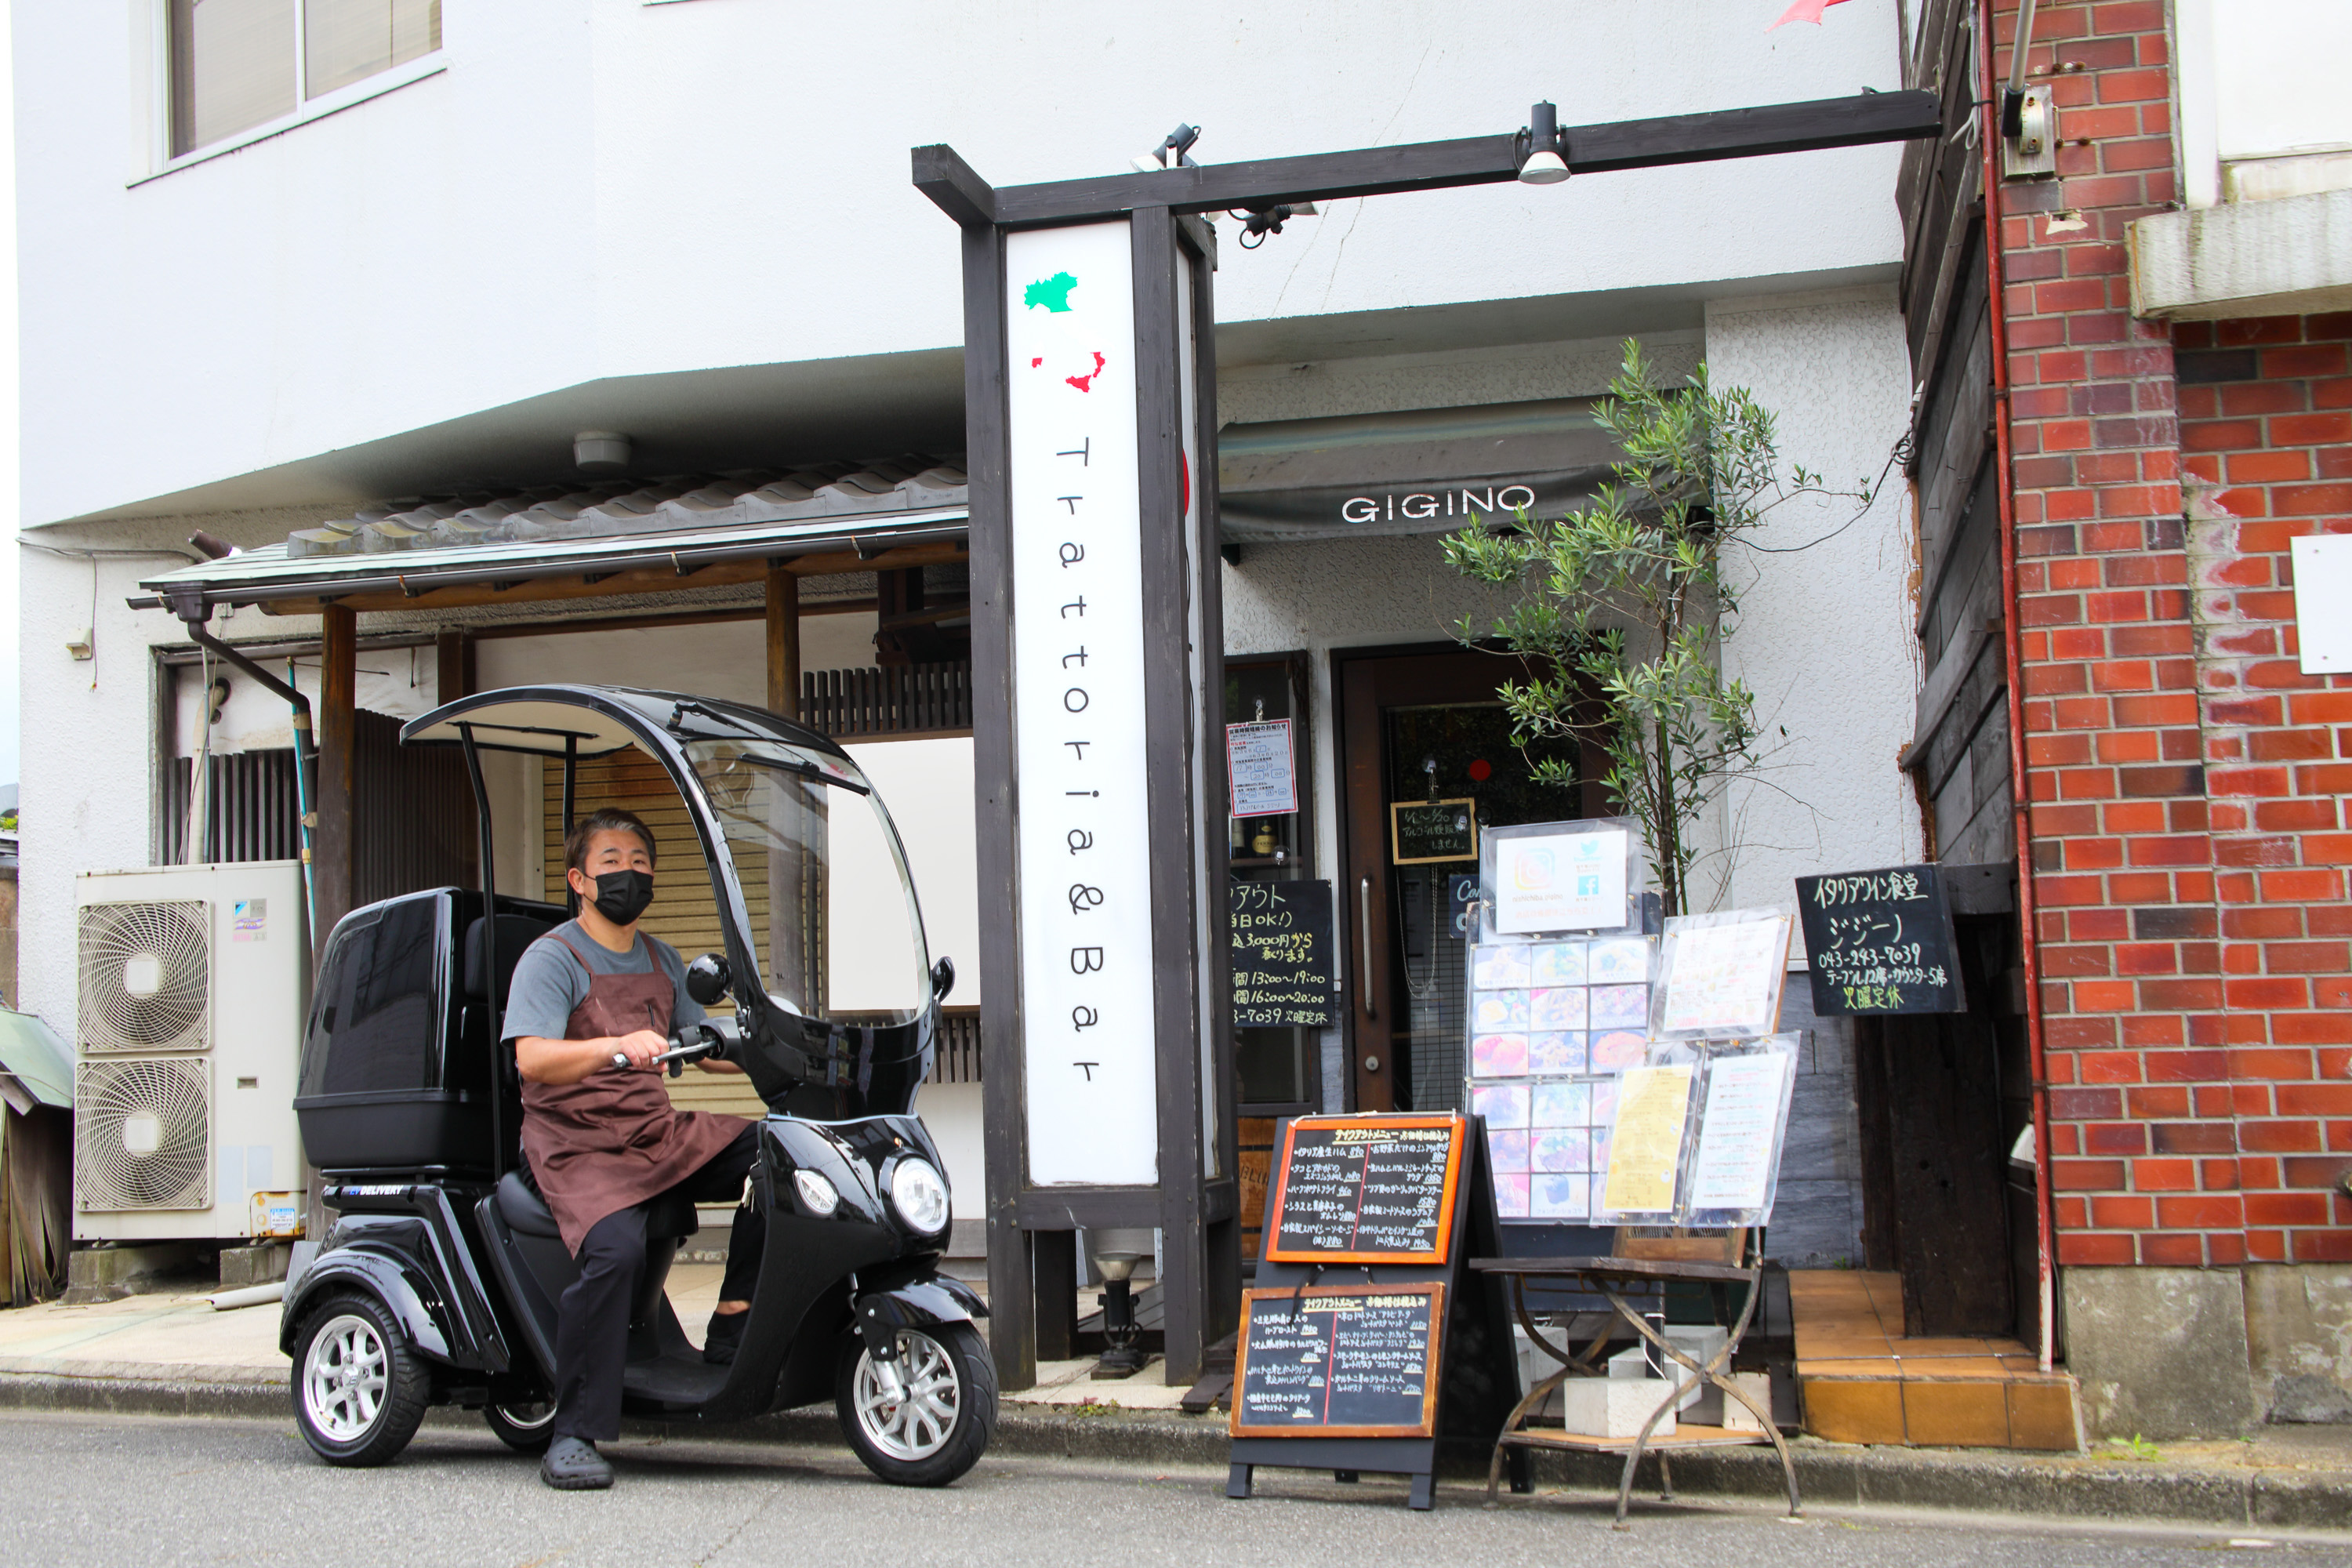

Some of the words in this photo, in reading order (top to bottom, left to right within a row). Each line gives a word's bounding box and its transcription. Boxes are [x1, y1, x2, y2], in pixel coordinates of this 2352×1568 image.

[1342, 485, 1535, 524] GIGINO
[1230, 884, 1287, 910] アウト
[1813, 871, 1929, 909] イタリアワイン食堂
[1829, 913, 1903, 950] ジジーノ
[1818, 942, 1921, 968] 043-243-7039
[1843, 985, 1905, 1010] 火曜定休
